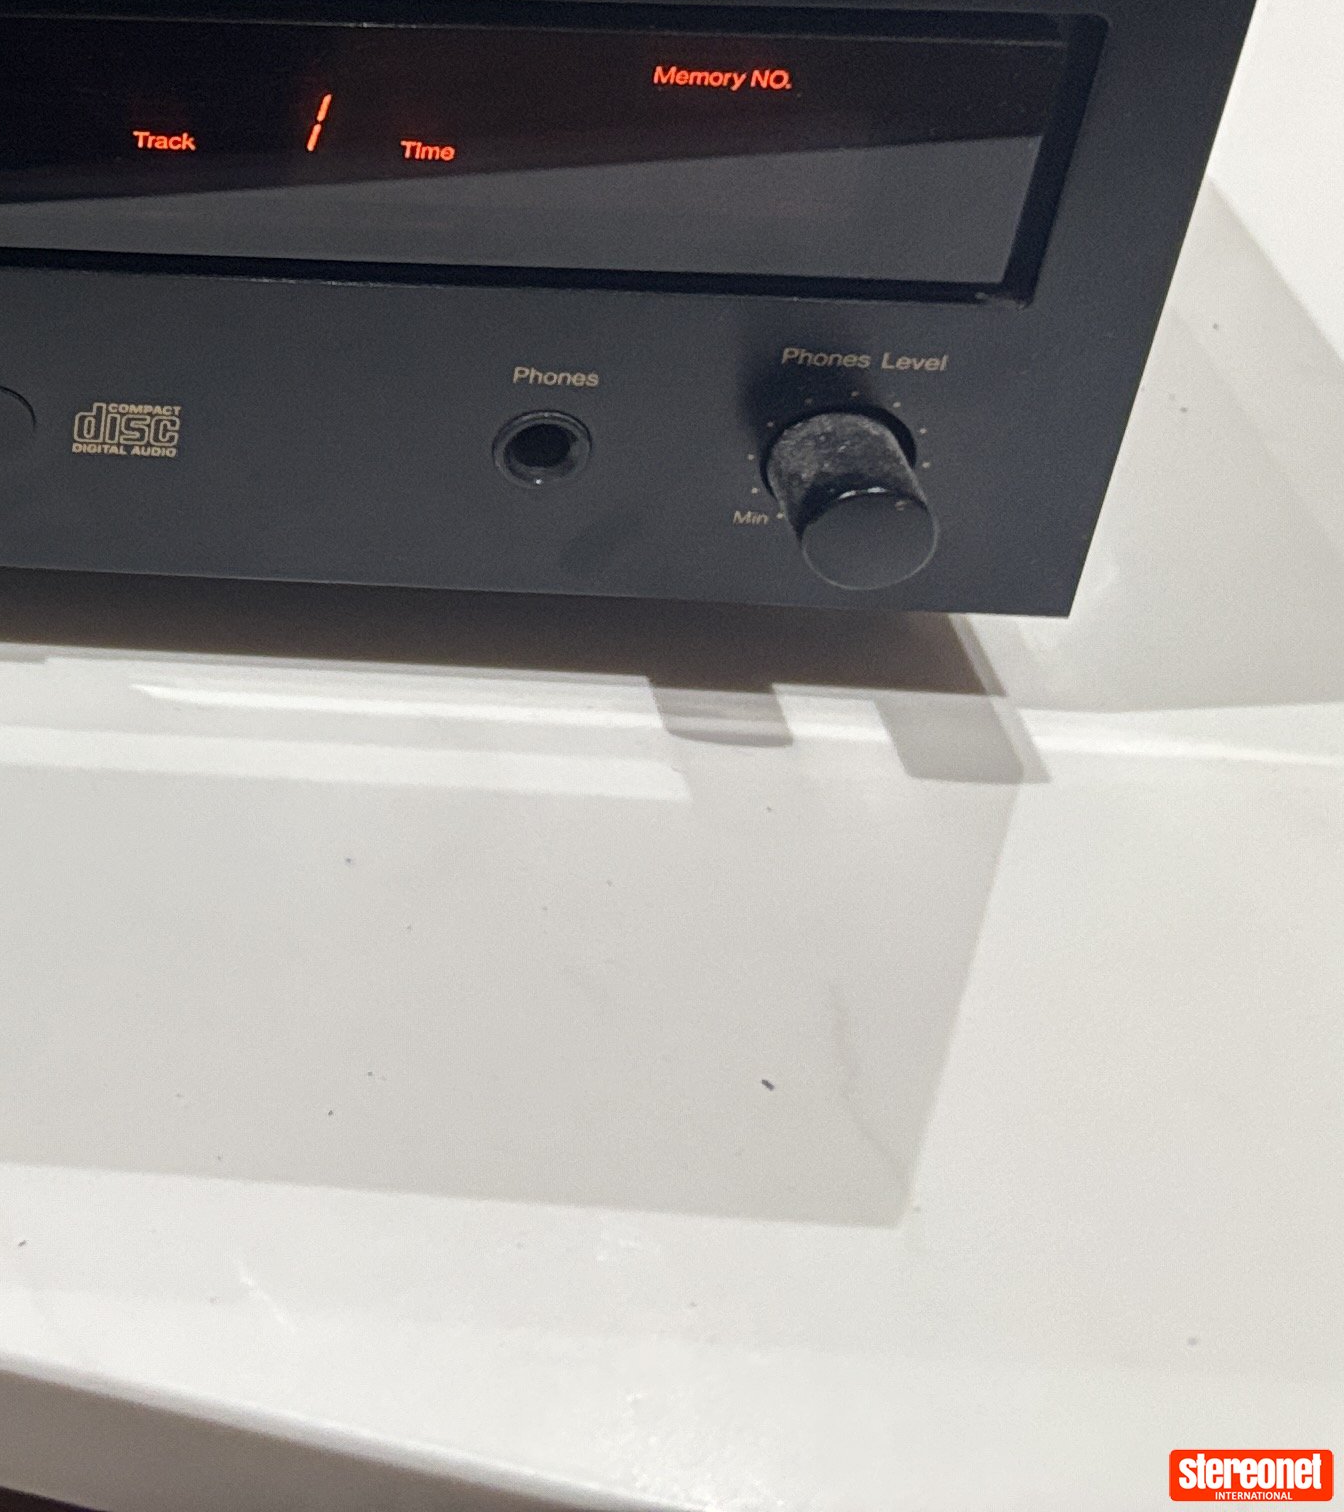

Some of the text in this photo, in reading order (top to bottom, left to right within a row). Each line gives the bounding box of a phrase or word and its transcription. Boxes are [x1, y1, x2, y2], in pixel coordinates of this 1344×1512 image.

[653, 65, 747, 91] Memory
[132, 130, 197, 152] Track
[399, 139, 456, 162] Time
[781, 347, 949, 372] Phones Level
[512, 366, 600, 388] Phones
[108, 402, 182, 416] COMPACT
[72, 443, 177, 458] DIGITAL AUDIO
[732, 509, 770, 526] Min
